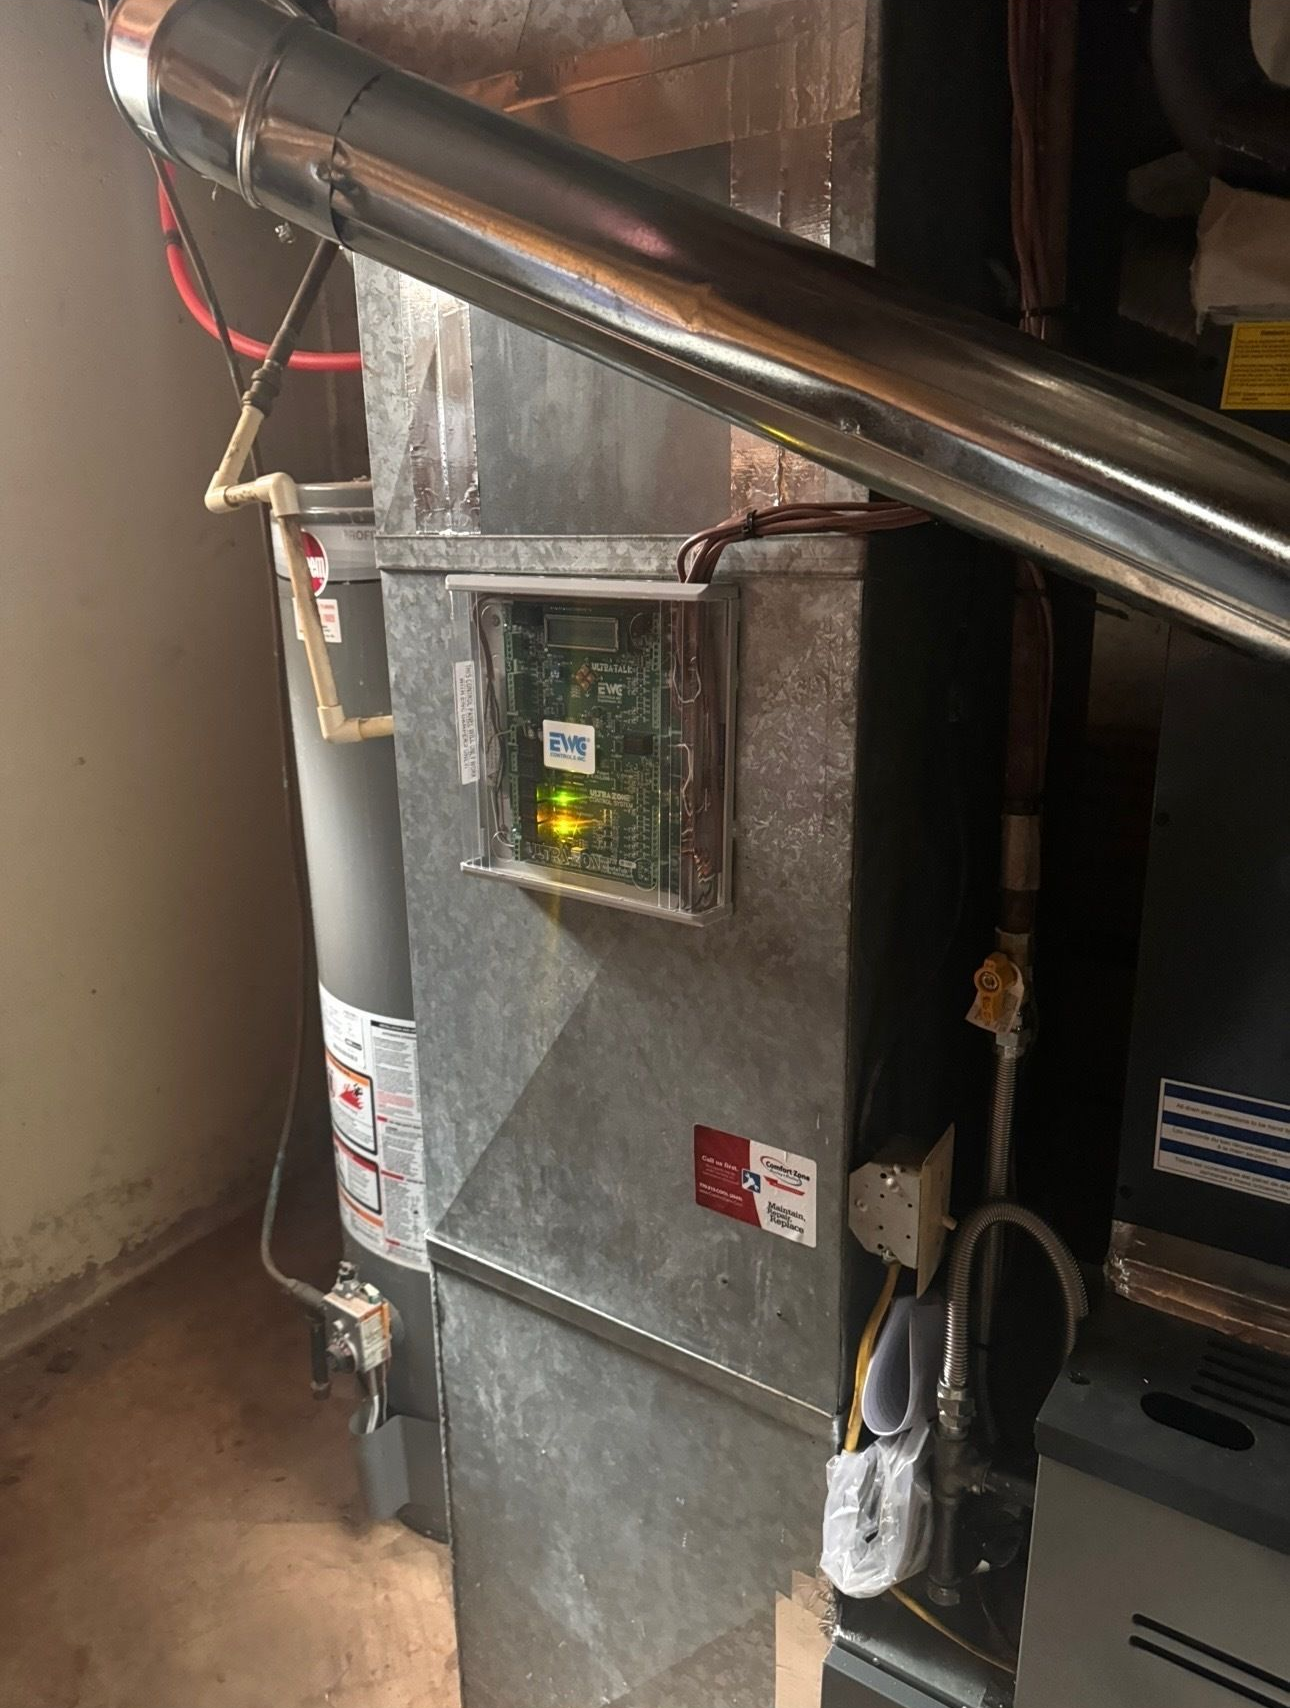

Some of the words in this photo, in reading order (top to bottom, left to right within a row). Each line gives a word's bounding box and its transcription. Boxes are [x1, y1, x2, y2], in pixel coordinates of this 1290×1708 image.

[549, 731, 587, 757] EWC
[765, 1161, 792, 1176] Comfort
[793, 1170, 810, 1181] Zone
[770, 1215, 805, 1234] Replace
